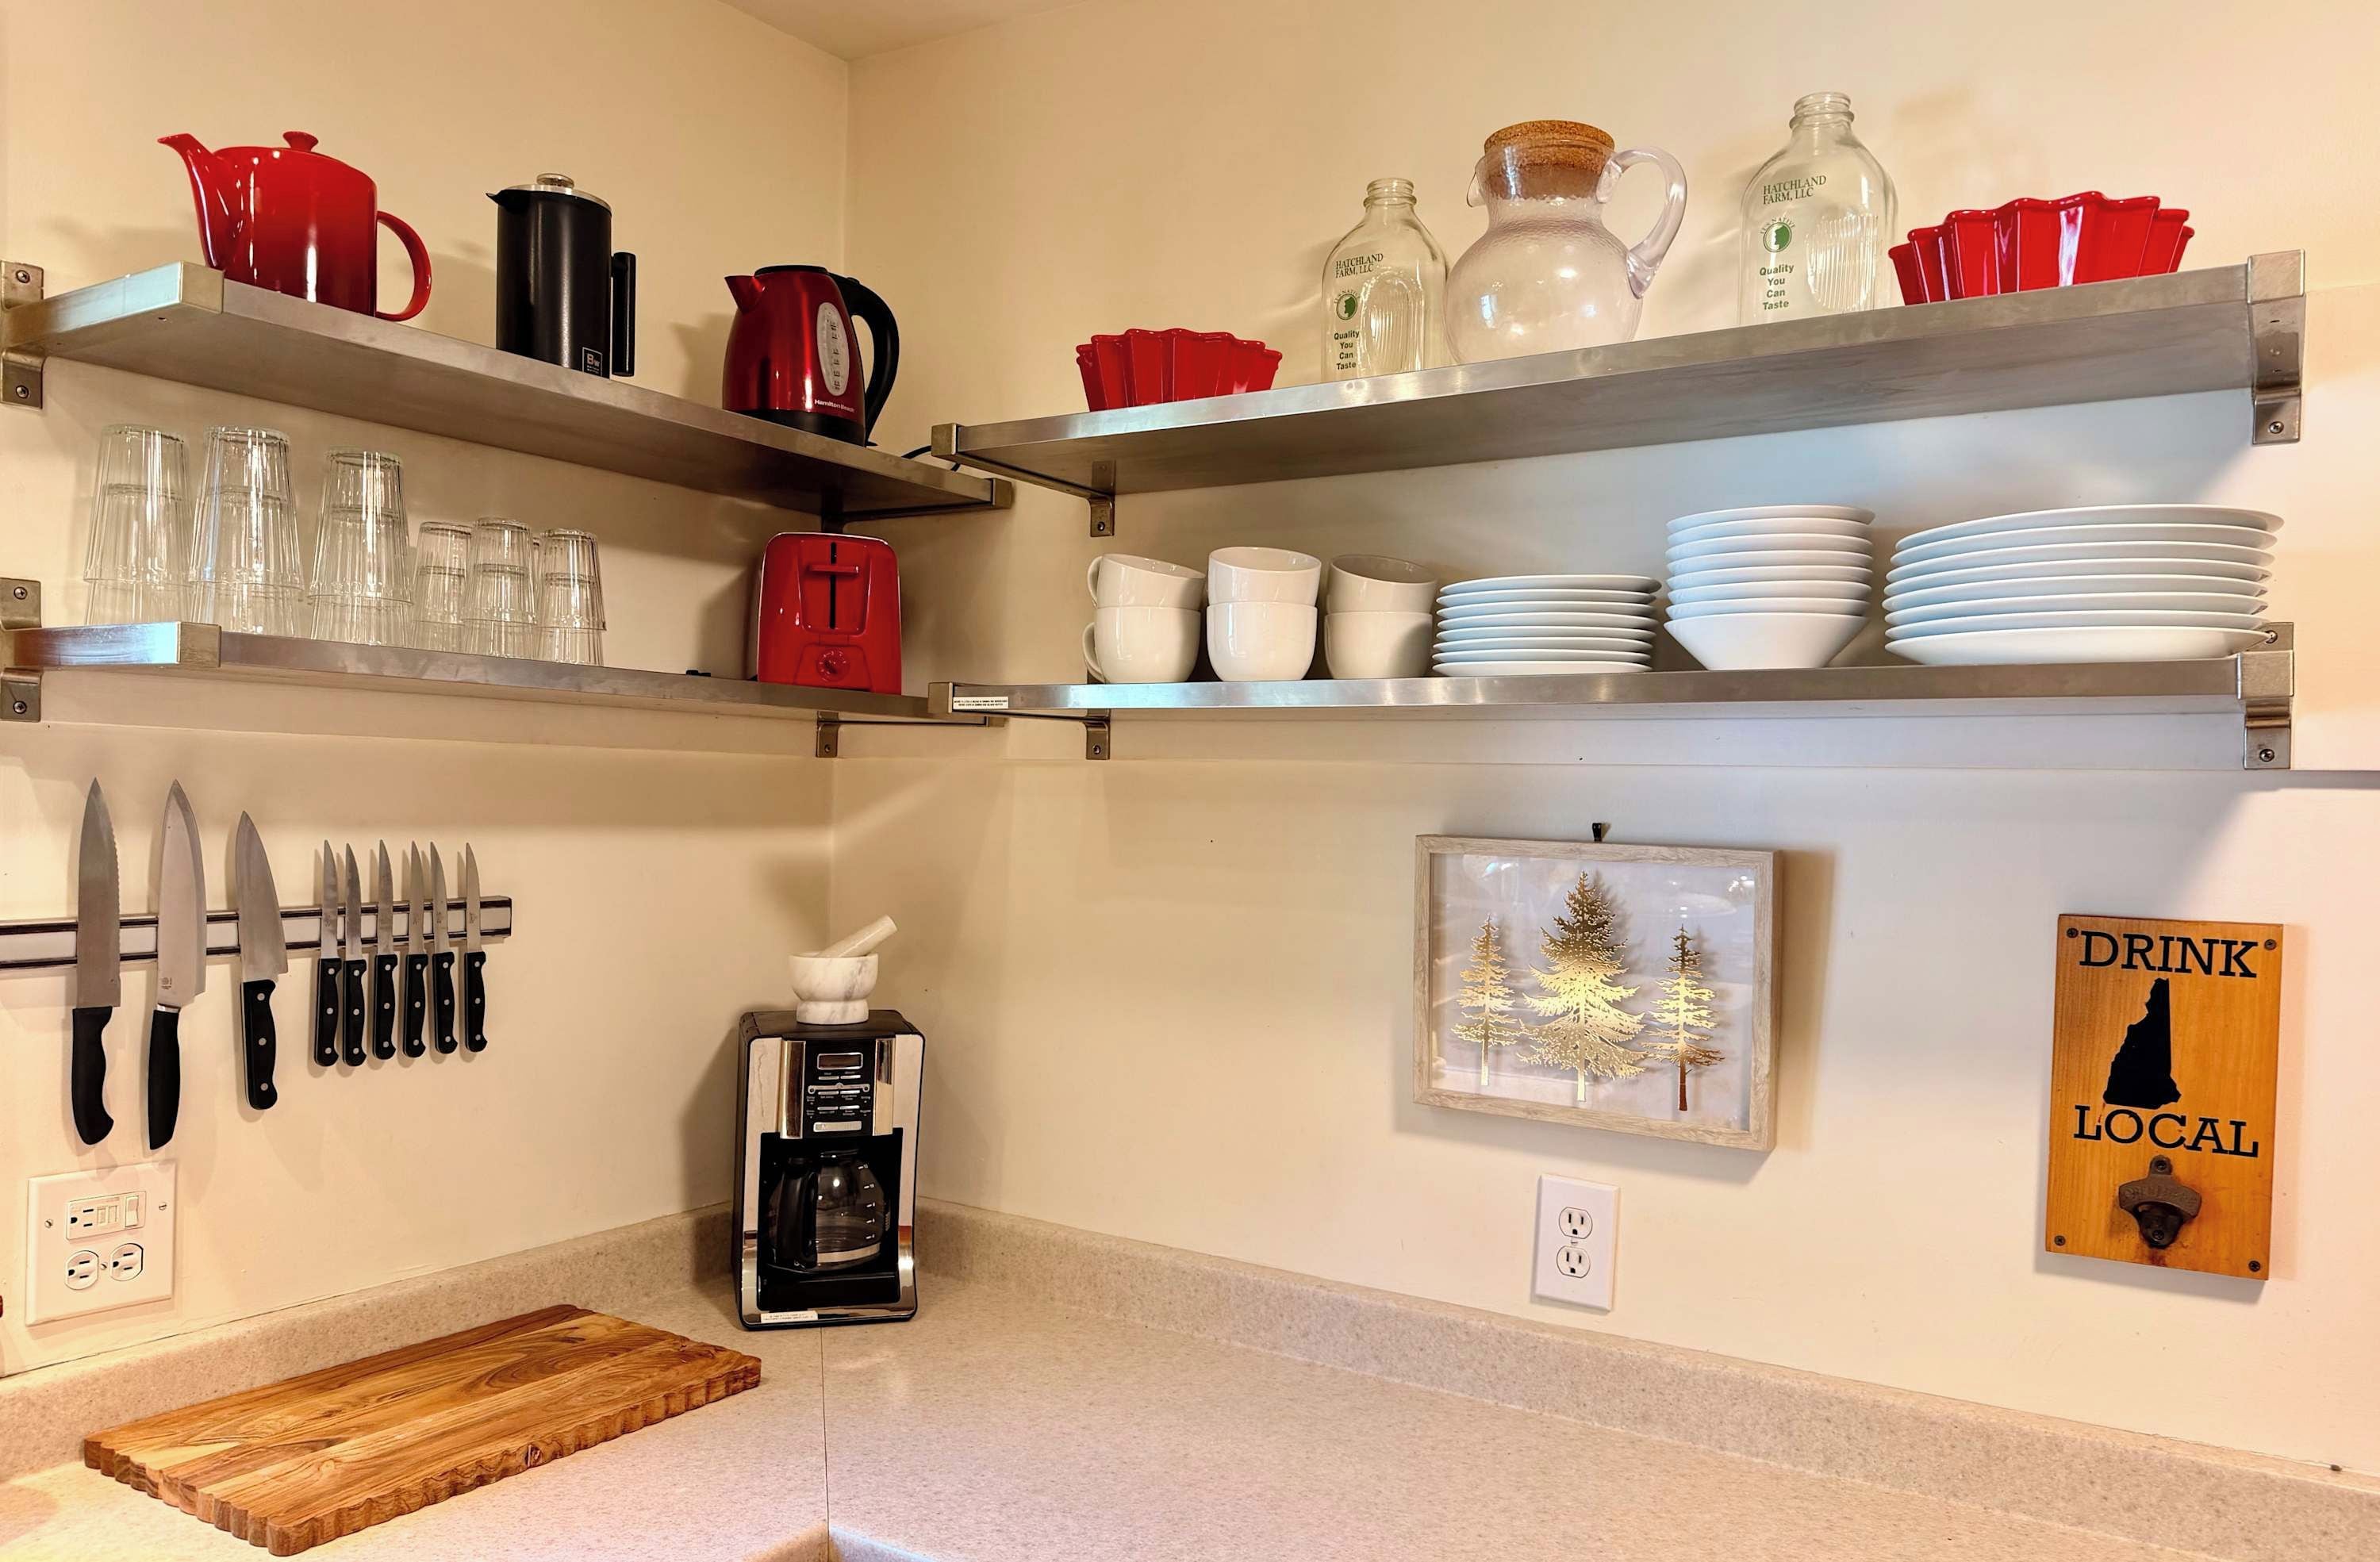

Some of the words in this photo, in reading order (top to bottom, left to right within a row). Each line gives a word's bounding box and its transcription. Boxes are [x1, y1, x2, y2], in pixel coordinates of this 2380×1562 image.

[1763, 175, 1827, 195] HATCHLAND
[1763, 192, 1793, 205] FARM,
[1795, 187, 1814, 200] LLC
[1335, 253, 1384, 270] HATCHLAND
[1335, 267, 1358, 278] FARM,
[1360, 263, 1374, 274] LLC
[1759, 264, 1794, 276] Quality
[1767, 277, 1786, 286] You
[1766, 288, 1786, 298] Can
[1762, 300, 1789, 311] Taste
[1334, 330, 1360, 340] Quality
[1339, 341, 1353, 350] You
[1339, 351, 1353, 360] Can
[1336, 362, 1357, 370] Taste
[814, 399, 841, 409] Hamilton
[2079, 930, 2259, 978] DRINK
[2073, 1104, 2259, 1158] LOCAL
